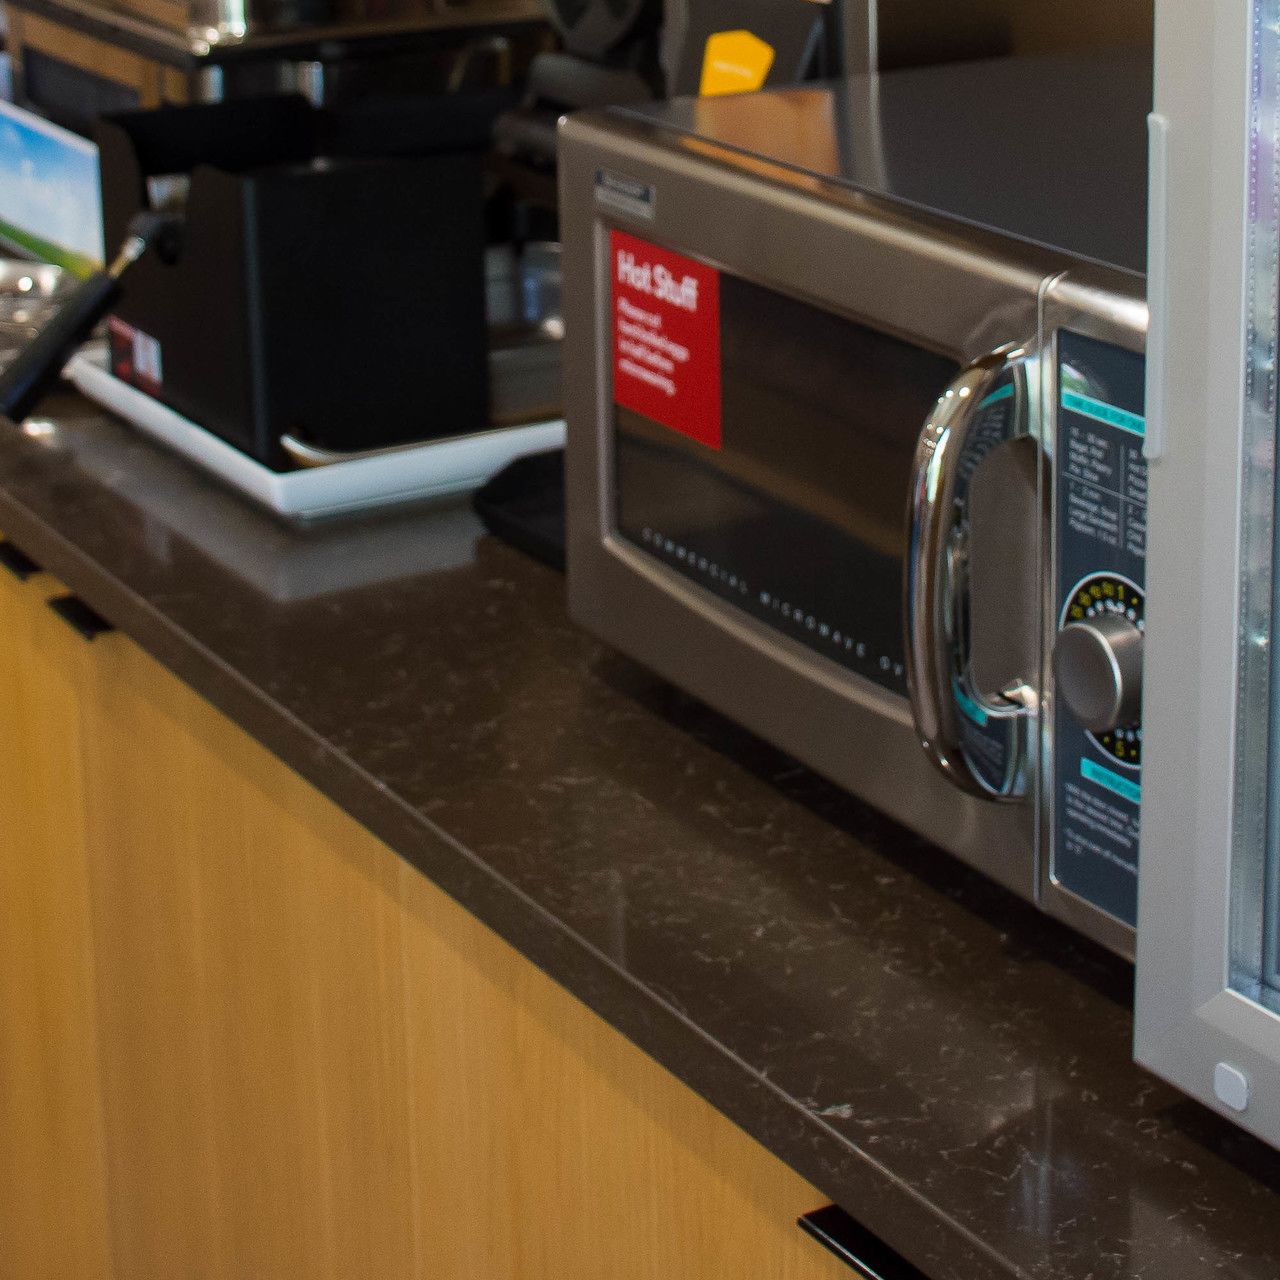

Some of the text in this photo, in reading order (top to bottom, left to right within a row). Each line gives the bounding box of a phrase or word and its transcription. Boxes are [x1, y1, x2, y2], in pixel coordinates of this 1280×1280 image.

[617, 248, 700, 312] Hot Stuff
[758, 589, 867, 659] MICROWAVE
